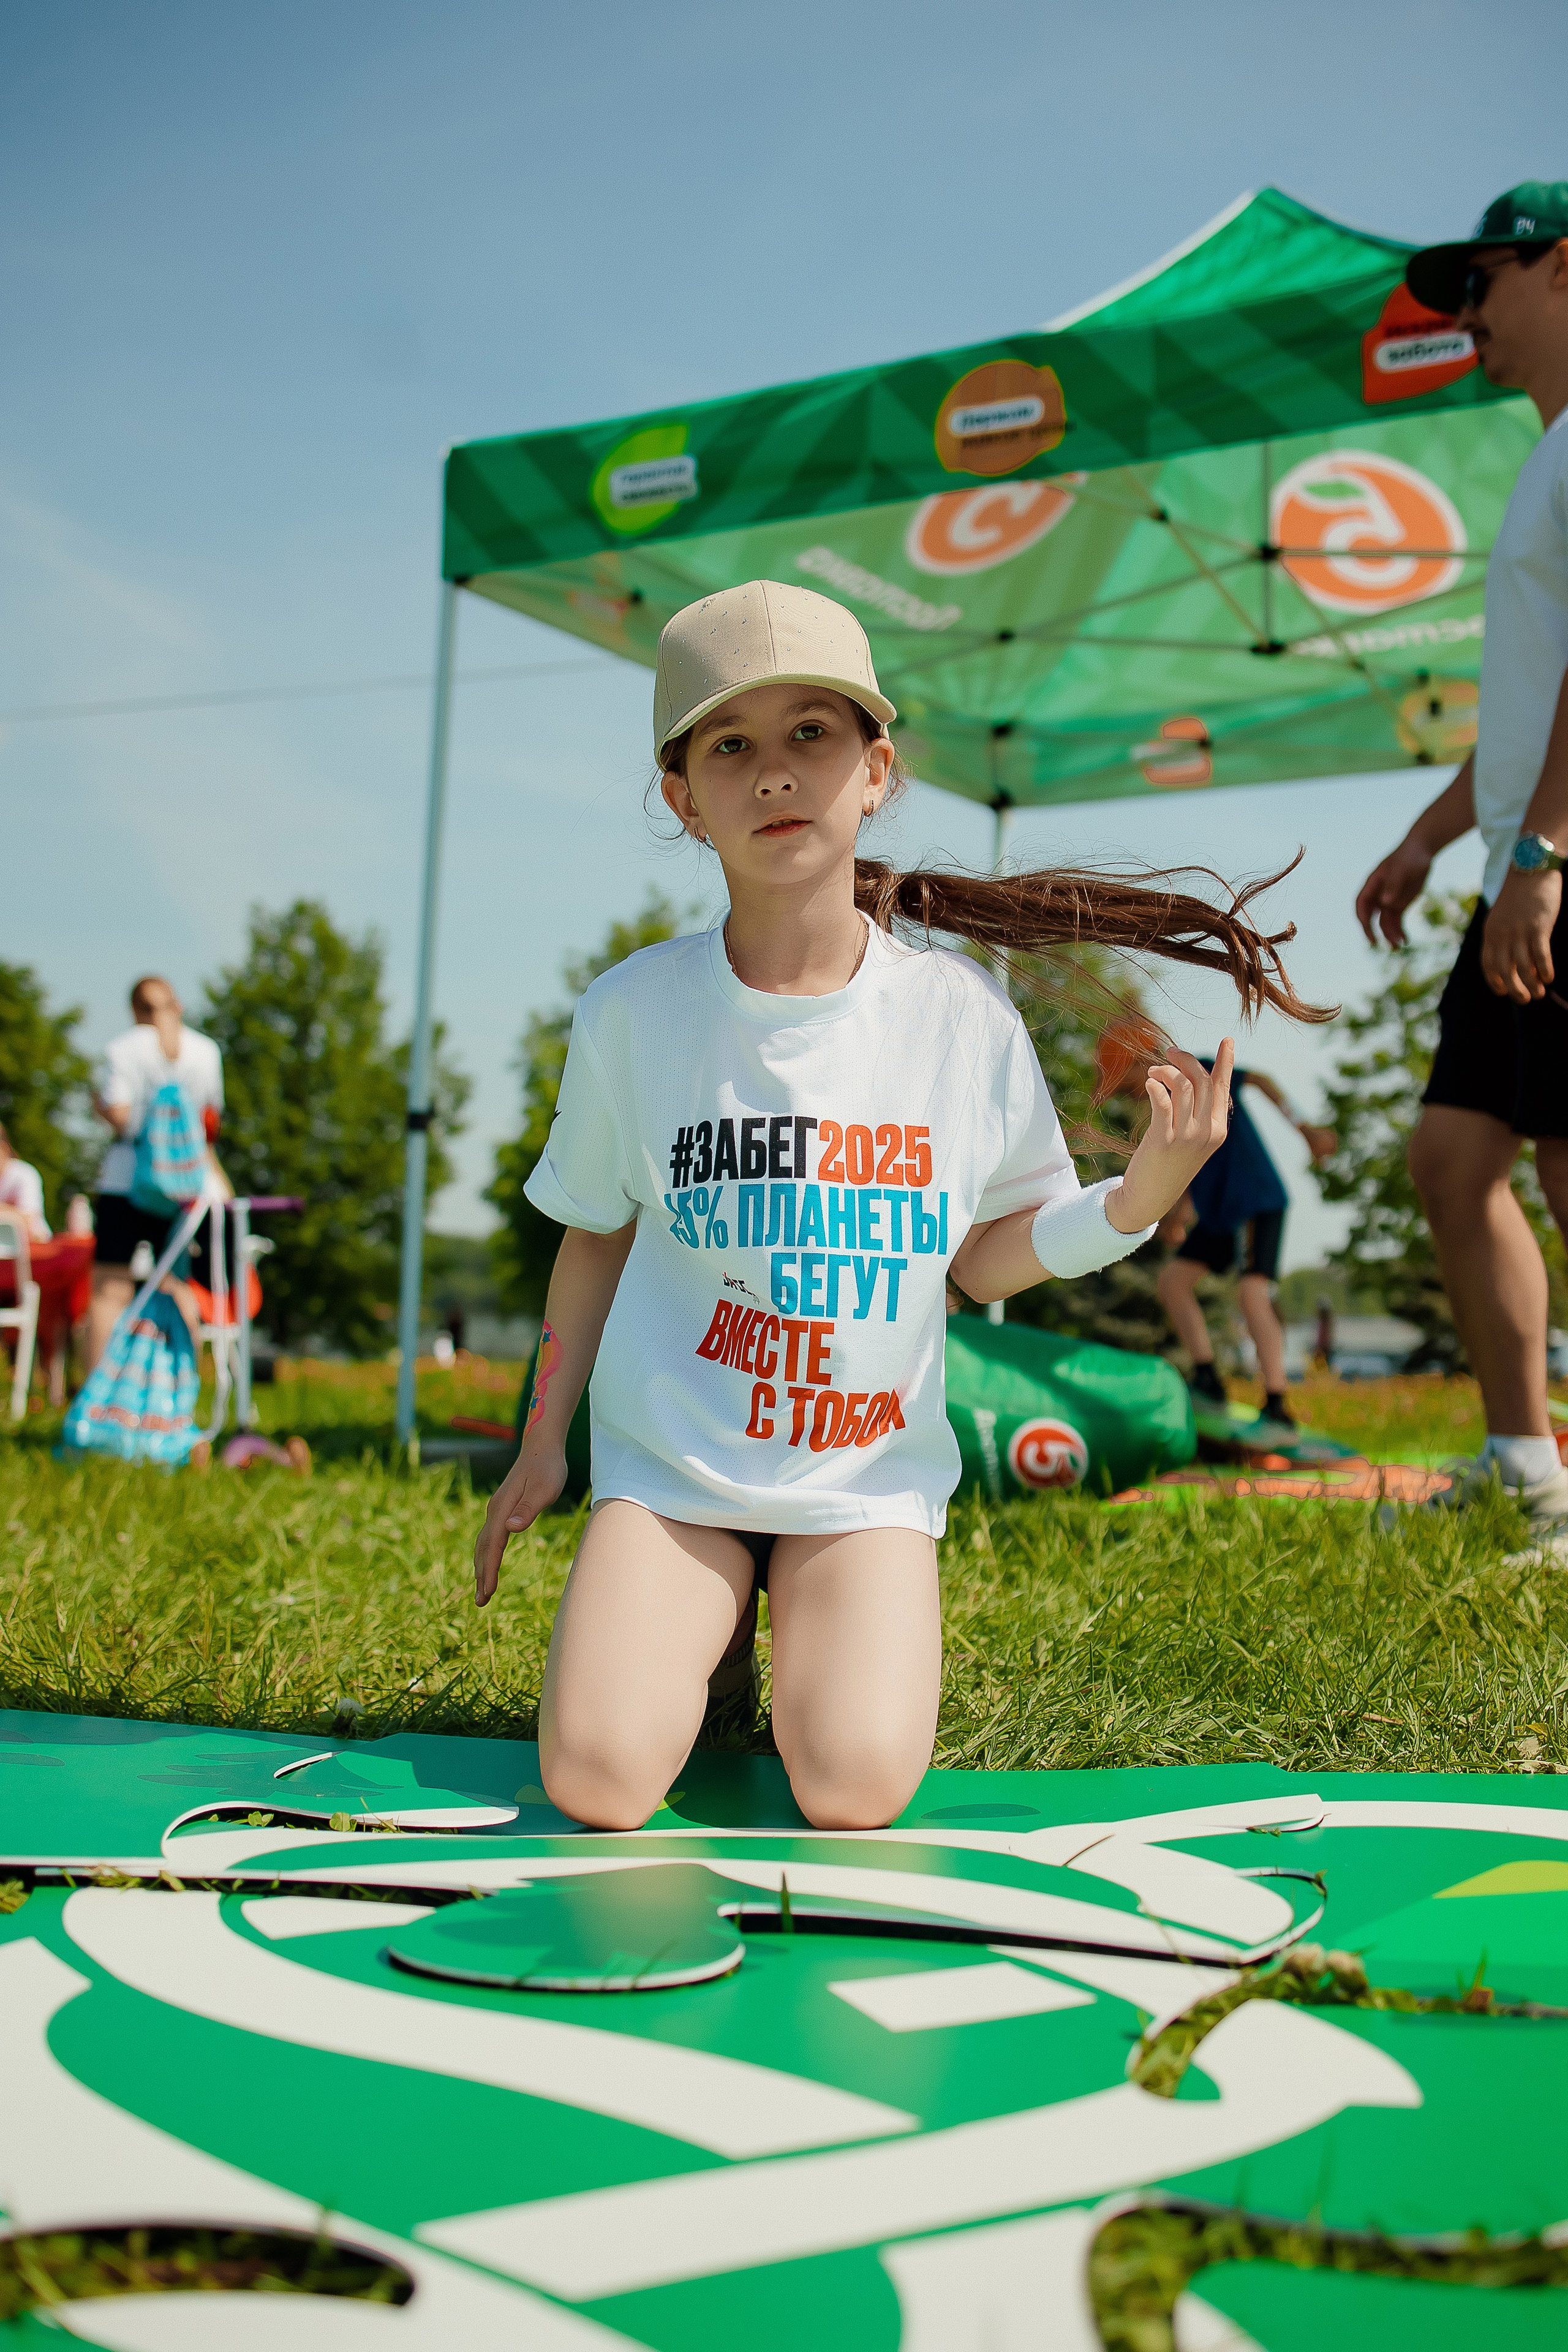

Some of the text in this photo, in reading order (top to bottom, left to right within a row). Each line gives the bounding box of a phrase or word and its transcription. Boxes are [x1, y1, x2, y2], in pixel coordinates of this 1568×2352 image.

[668, 1115, 933, 1189] #ЗАБЕГ2025
[737, 1183, 949, 1256] ПЛАНЕТЫ
[771, 1252, 908, 1322] БЕГУТ
[695, 1298, 835, 1386] ВМЕСТЕ
[745, 1381, 777, 1440] С
